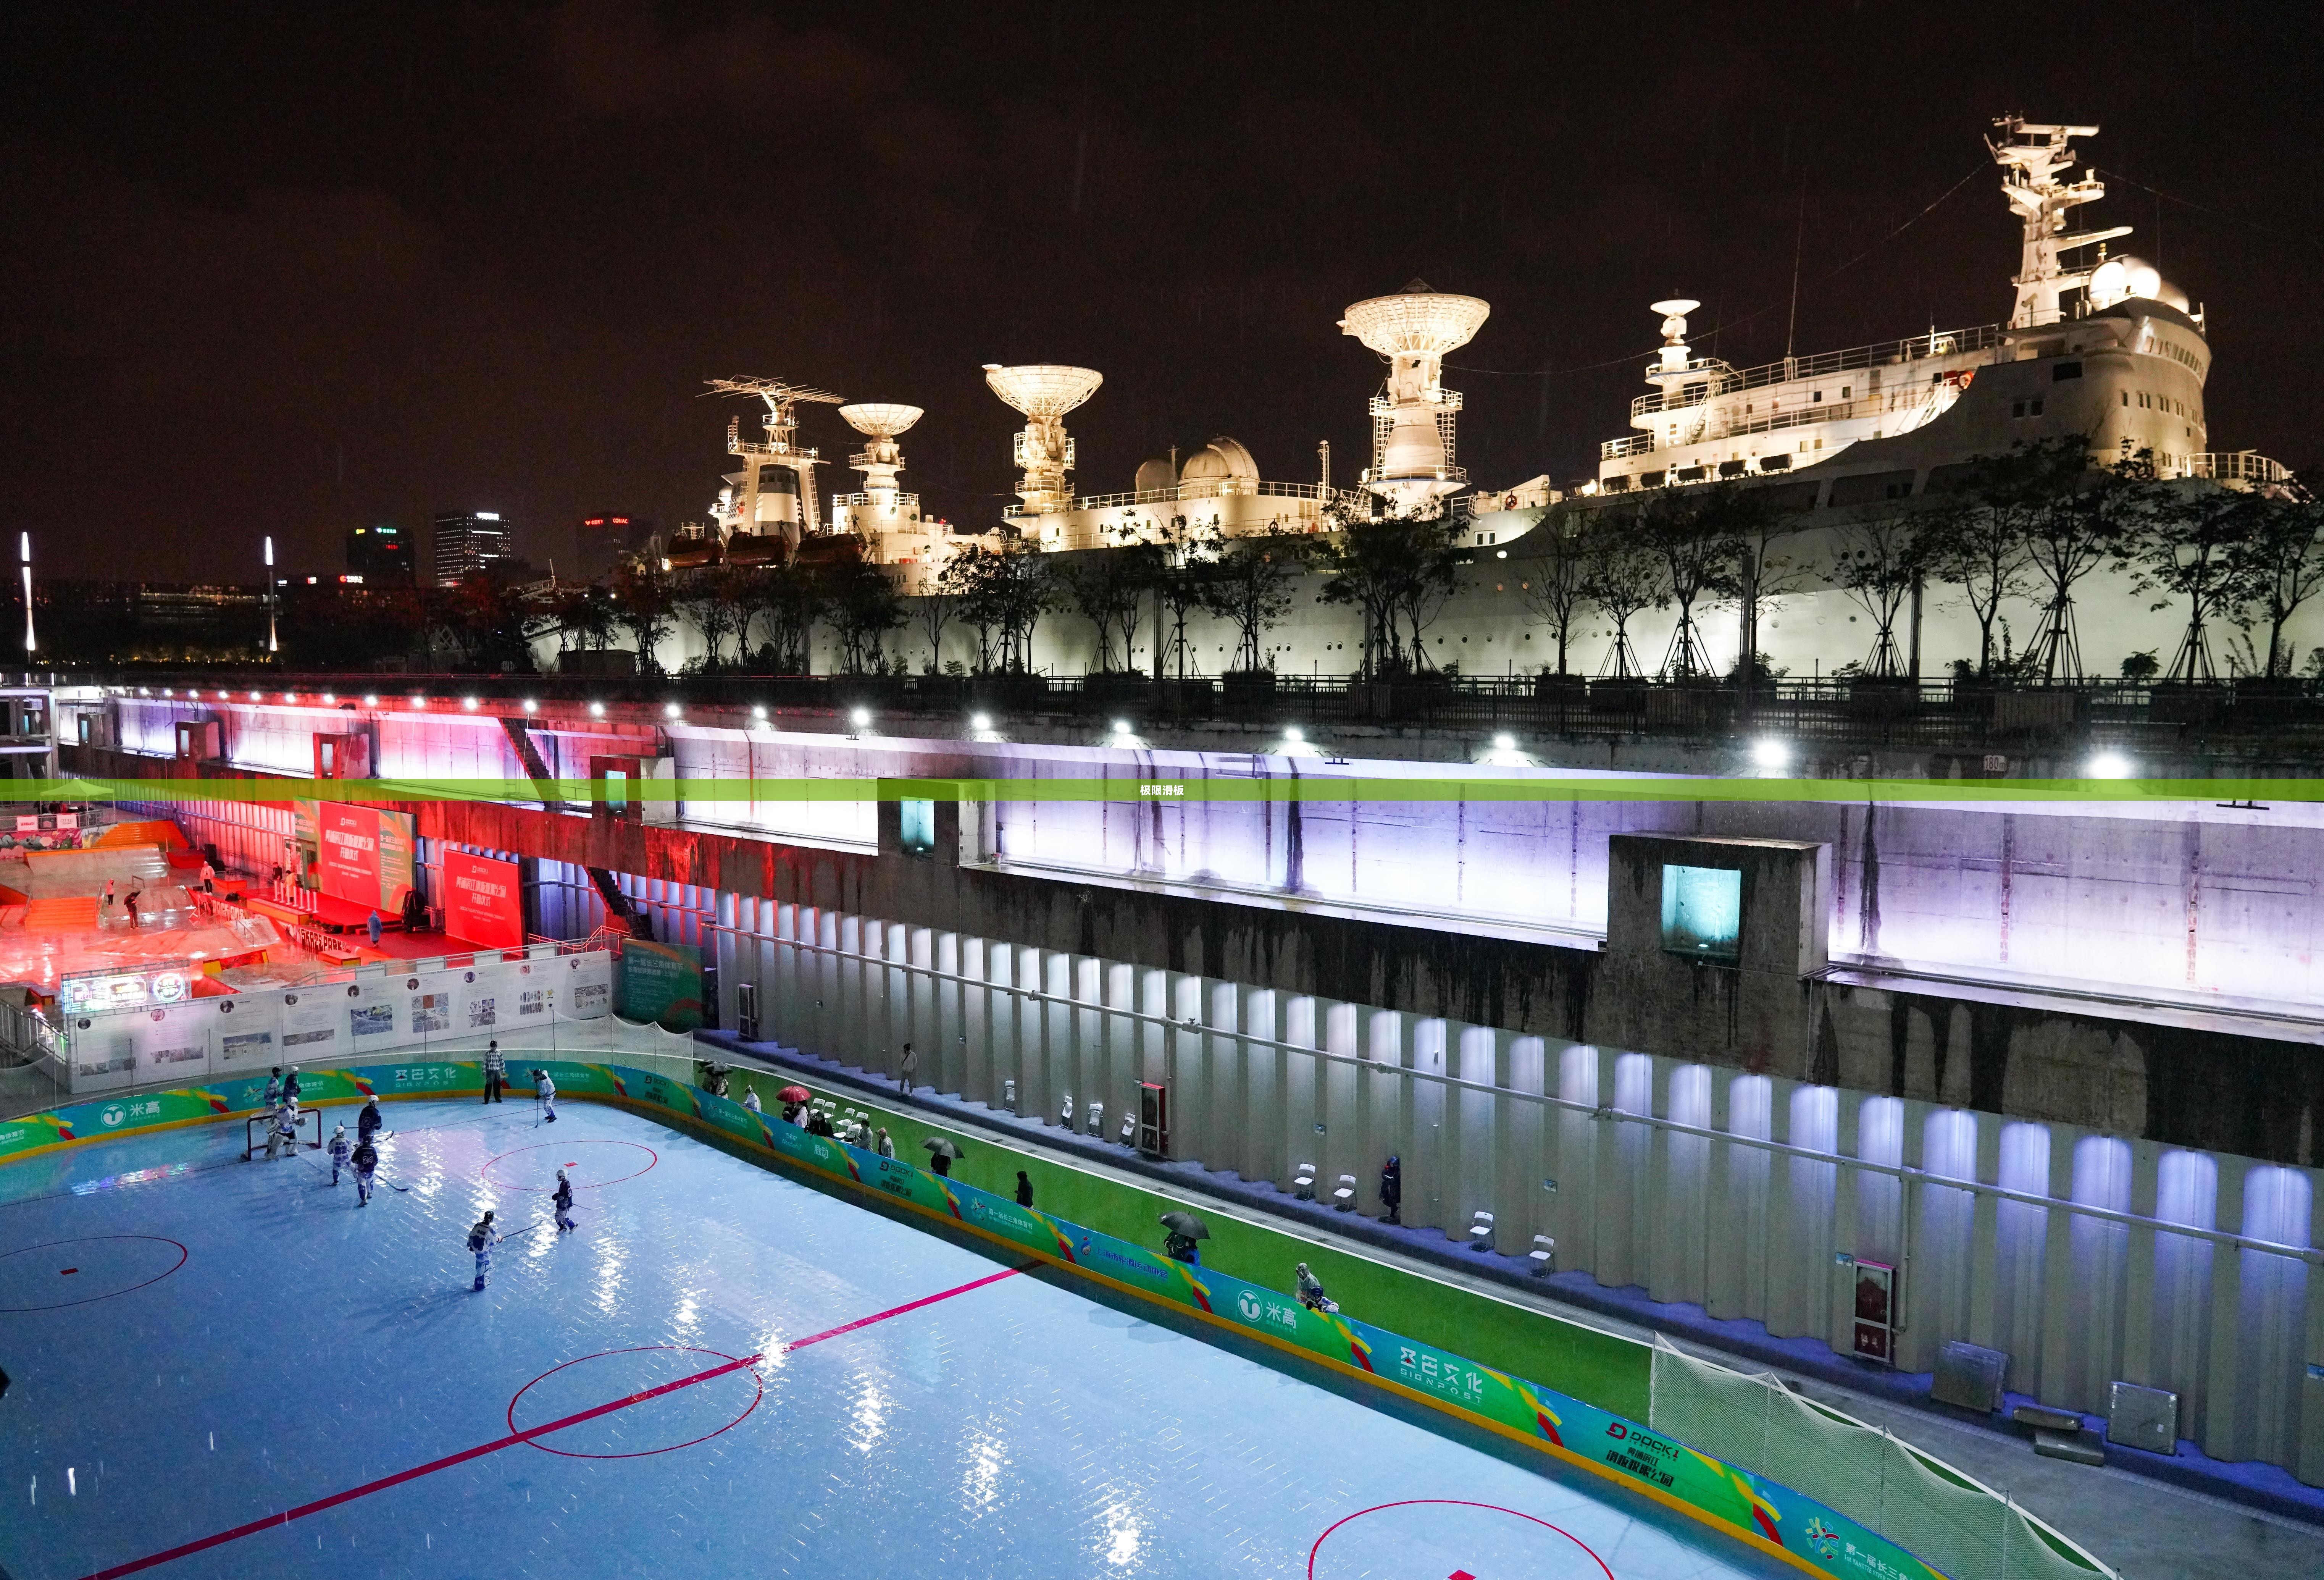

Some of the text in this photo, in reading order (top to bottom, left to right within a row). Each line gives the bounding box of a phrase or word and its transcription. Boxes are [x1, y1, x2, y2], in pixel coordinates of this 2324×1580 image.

[1985, 757, 2005, 770] 180m
[130, 1100, 160, 1117] 米高
[814, 1144, 828, 1160] 脉动
[989, 1208, 1033, 1229] 第一届长三角体育节
[1097, 1246, 1167, 1278] 上海市轮滑运动协会
[1266, 1301, 1296, 1329] 米高
[1401, 1368, 1482, 1403] SIGNPOST
[1627, 1447, 1656, 1467] 黄浦滨江
[1628, 1439, 1677, 1462] SKATEPARK
[1606, 1450, 1674, 1487] 滑板极限公园
[1853, 1559, 1872, 1574] YANGTZE
